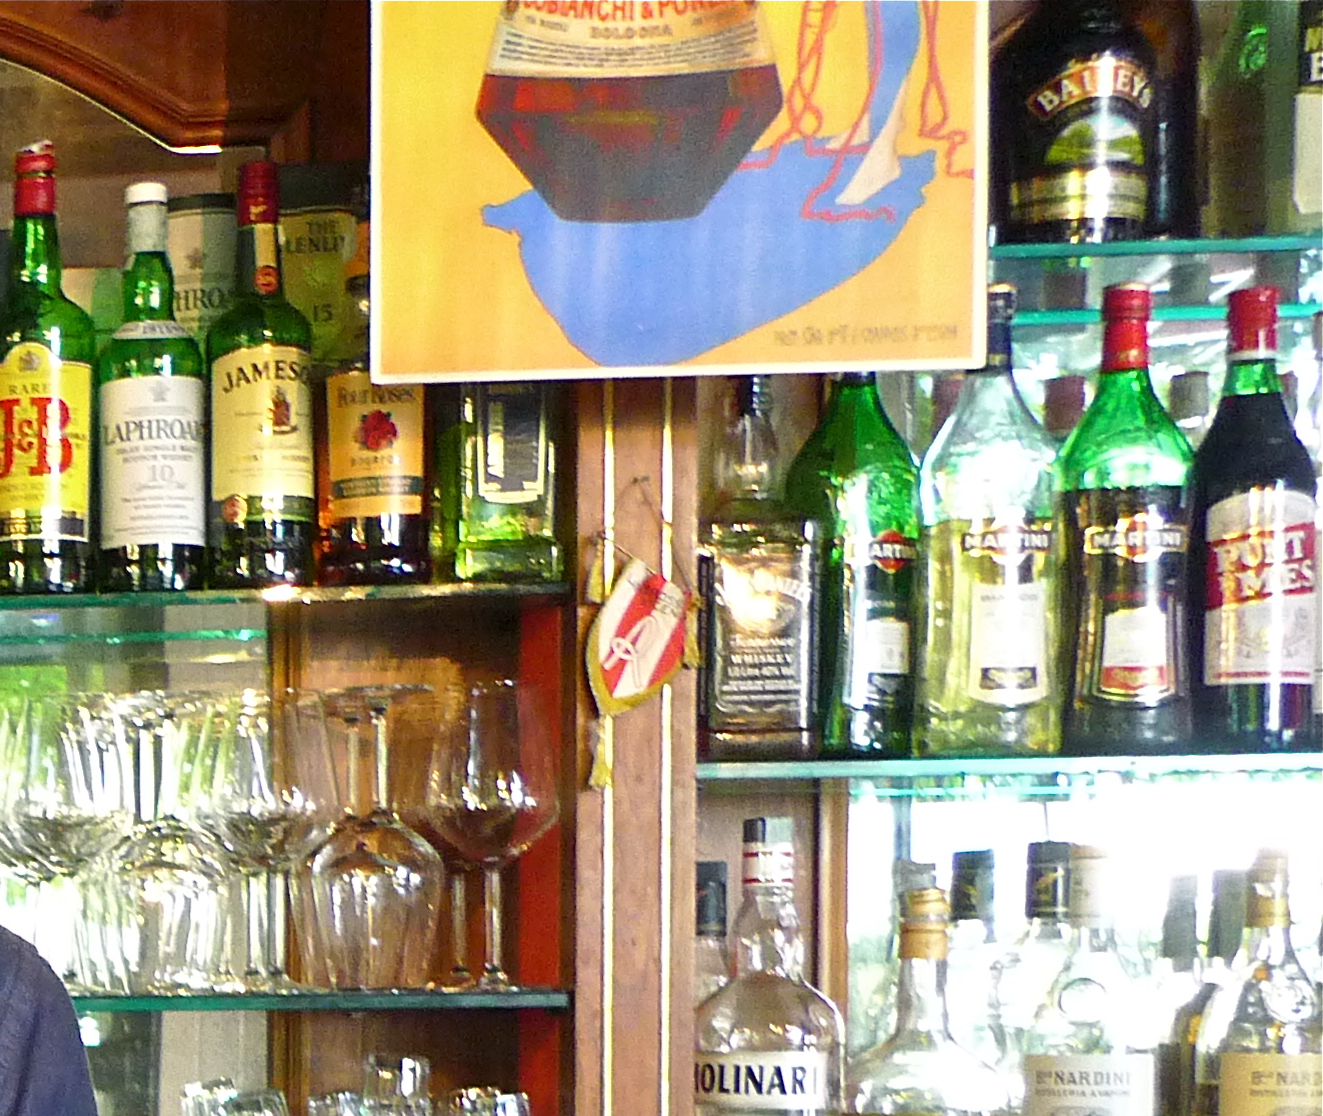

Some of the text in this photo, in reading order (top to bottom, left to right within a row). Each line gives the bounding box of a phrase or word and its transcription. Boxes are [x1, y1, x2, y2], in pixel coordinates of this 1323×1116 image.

[1036, 70, 1154, 113] BAIEYS
[307, 220, 336, 234] THE
[311, 303, 332, 322] 15
[149, 465, 175, 482] 10
[963, 533, 1049, 550] MARTINI
[730, 654, 792, 664] WHISKEY
[1053, 1070, 1132, 1087] NARDINI
